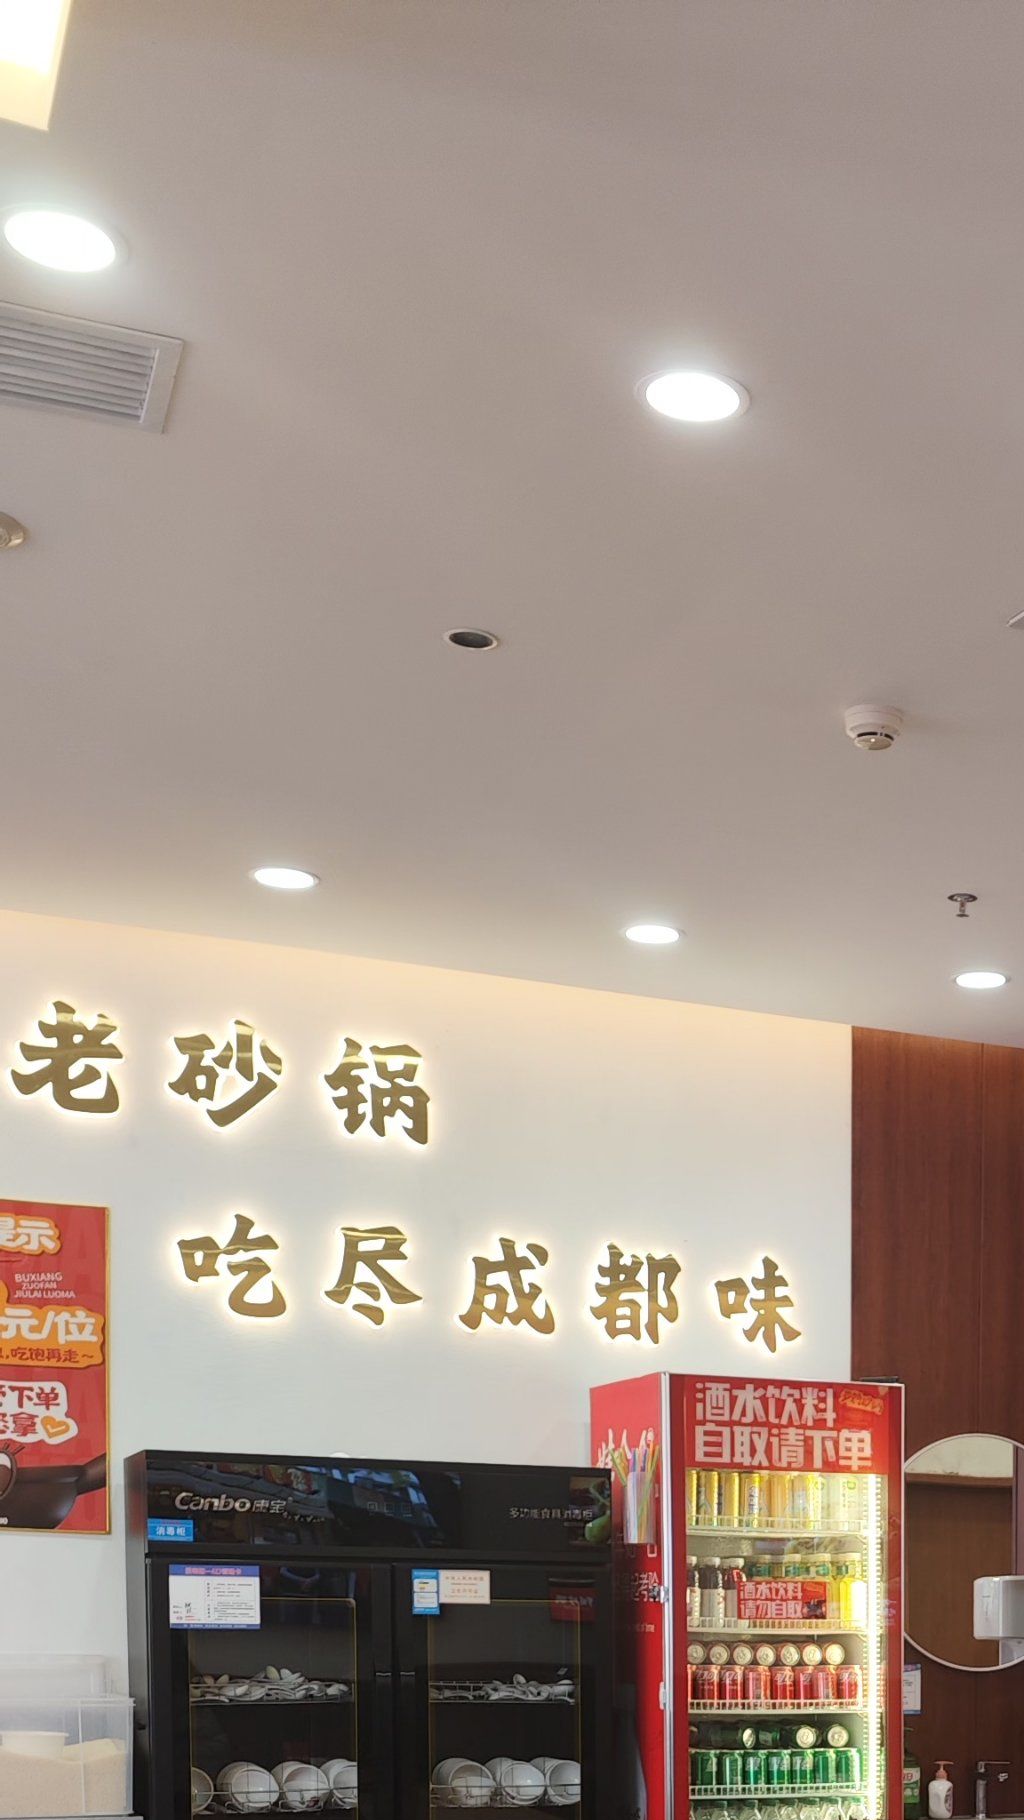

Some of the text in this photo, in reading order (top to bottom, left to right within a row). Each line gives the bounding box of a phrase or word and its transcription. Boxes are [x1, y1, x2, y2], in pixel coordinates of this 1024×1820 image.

[10, 1000, 432, 1146] 老砂锅
[176, 1214, 803, 1354] 吃尽成都味
[0, 1385, 60, 1411] 下单
[695, 1382, 836, 1428] 酒水饮料
[695, 1422, 873, 1471] 自取请下单
[175, 1491, 250, 1512] Canbo
[740, 1581, 803, 1600] 酒水饮料
[740, 1600, 803, 1618] 请勿自取
